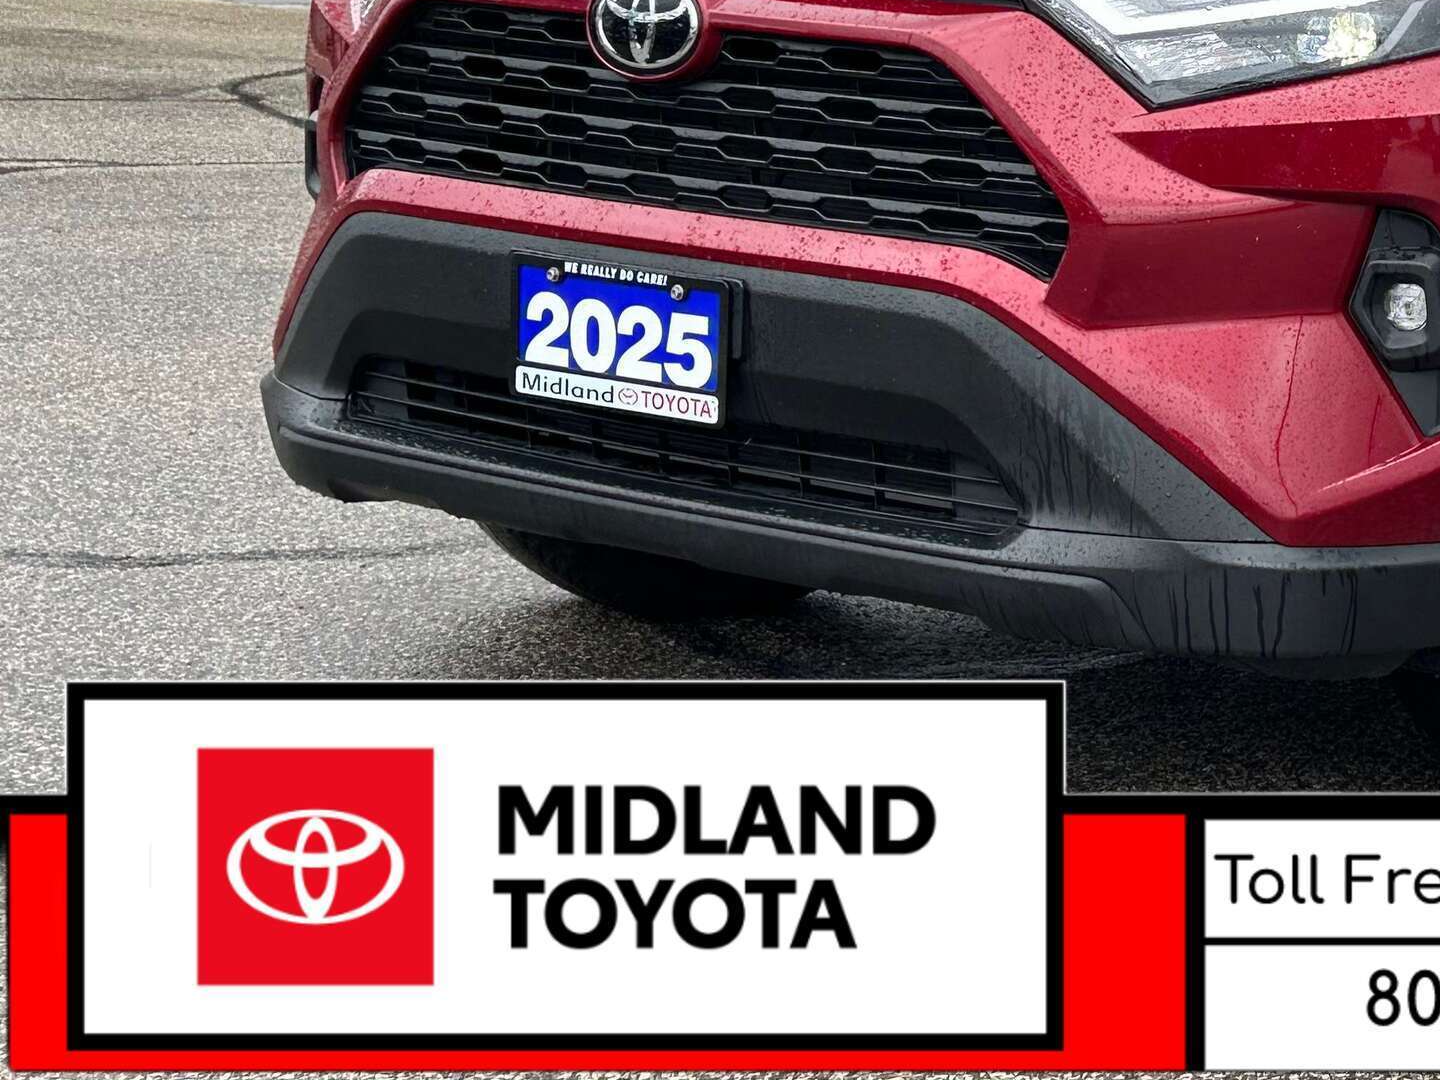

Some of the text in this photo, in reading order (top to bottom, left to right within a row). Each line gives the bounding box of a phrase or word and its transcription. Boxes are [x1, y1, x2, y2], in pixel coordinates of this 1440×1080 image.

[564, 261, 668, 287] WE REALLY DO CARE!
[524, 291, 713, 389] 2025
[522, 372, 712, 418] Midland TOYOTA
